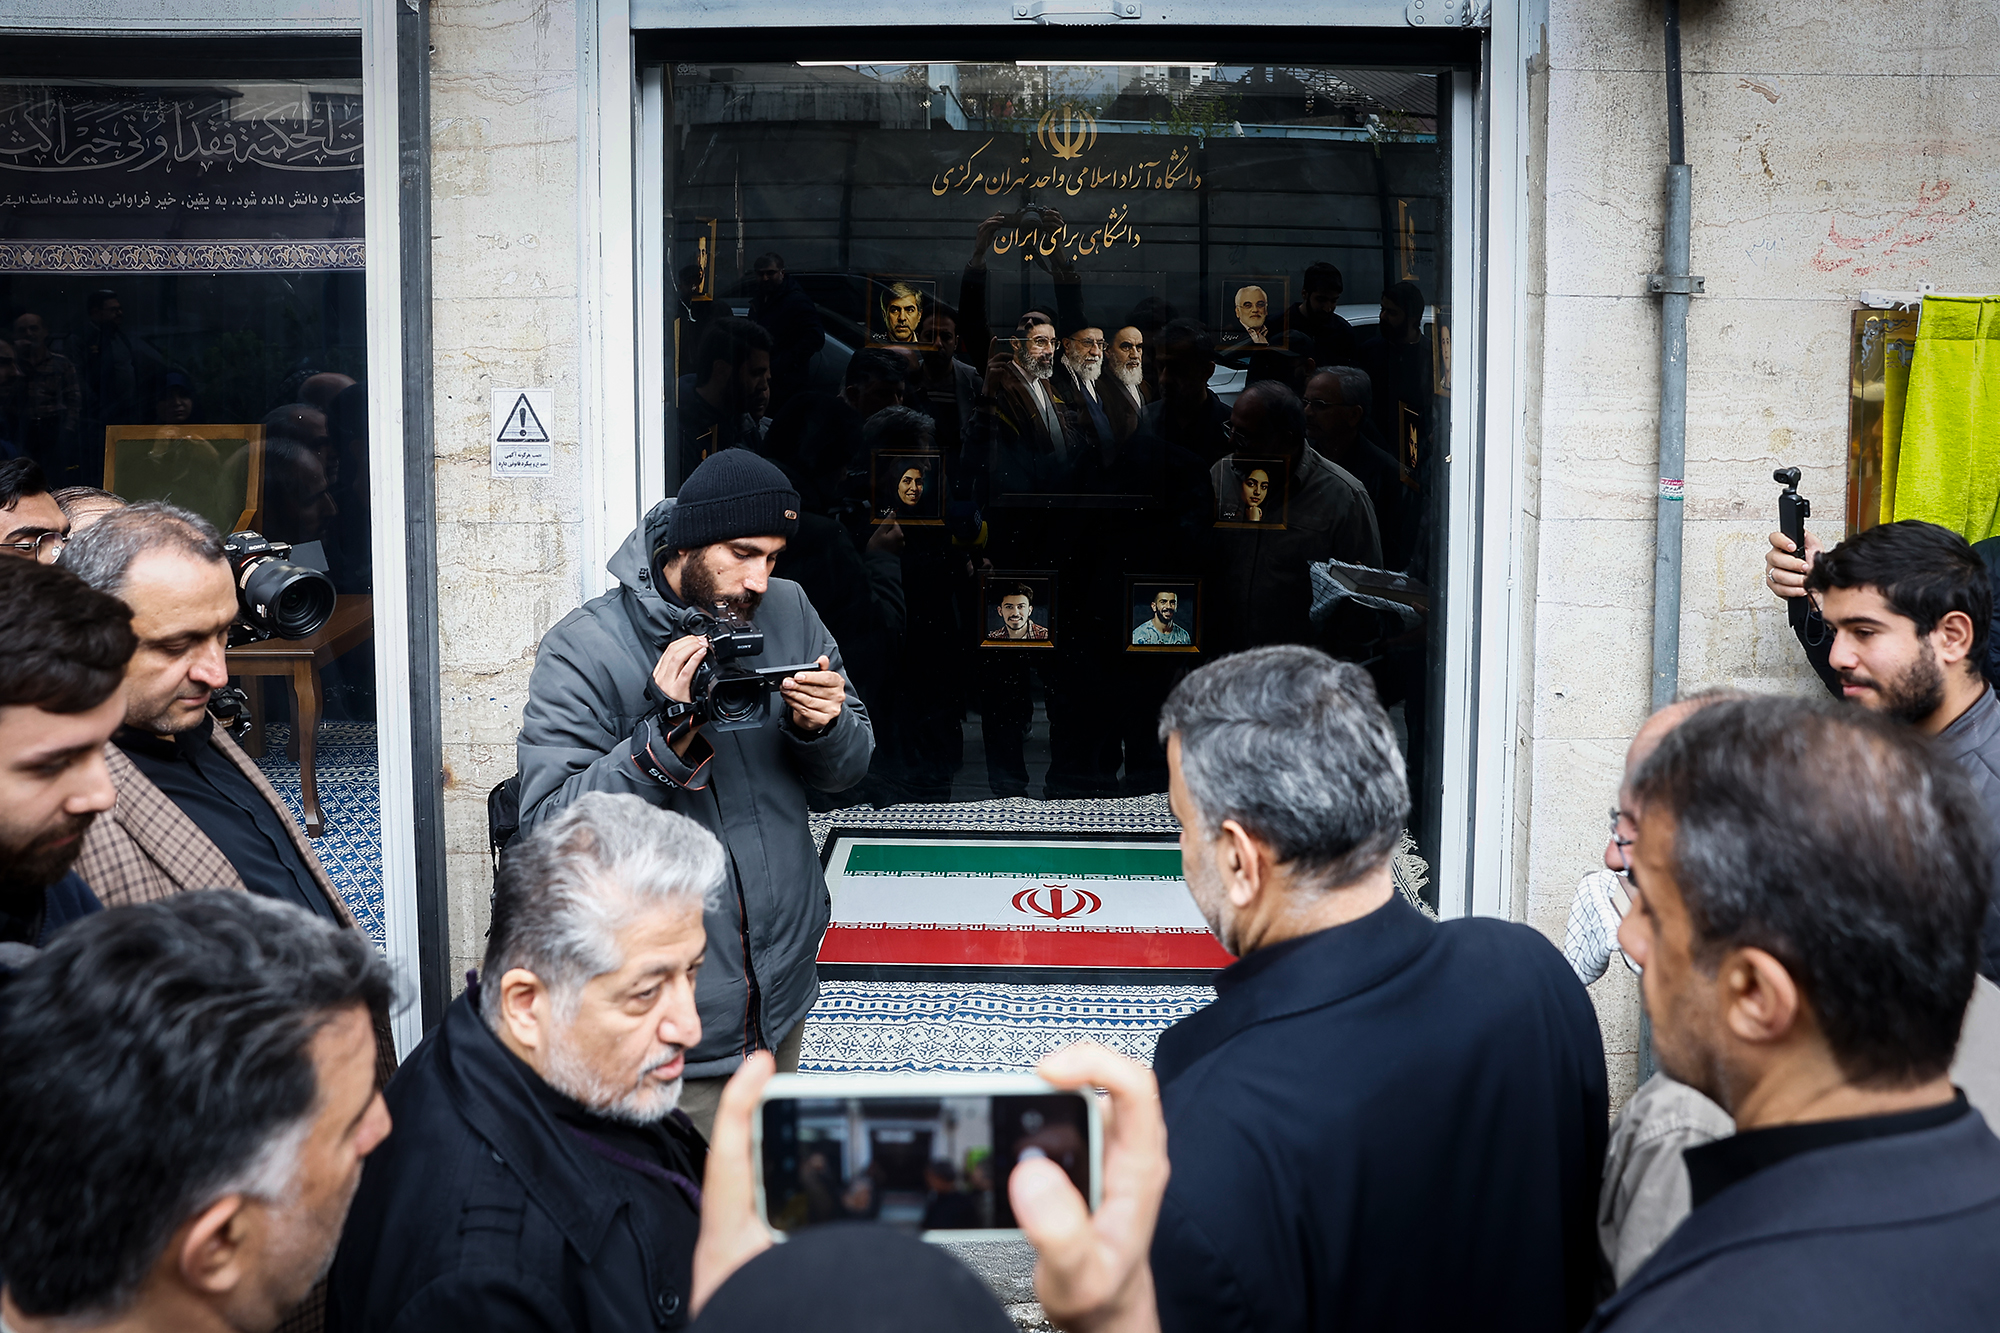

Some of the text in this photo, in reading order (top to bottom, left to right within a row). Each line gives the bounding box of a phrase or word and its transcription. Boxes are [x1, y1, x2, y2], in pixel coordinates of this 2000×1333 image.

[931, 136, 1202, 196] دانشگاه آزاد اسلامی واحد تهران مرکزی
[56, 189, 79, 205] شده
[82, 193, 105, 205] داده
[107, 190, 151, 209] فراوانی
[154, 191, 177, 210] خیر
[214, 194, 228, 211] به
[260, 193, 285, 205] داده
[288, 190, 319, 209] دانش
[320, 195, 329, 208] و
[331, 191, 365, 206] حکمت
[993, 203, 1141, 262] دانشگاهی برای ایران
[248, 543, 266, 551] SONY
[648, 767, 679, 789] SON
